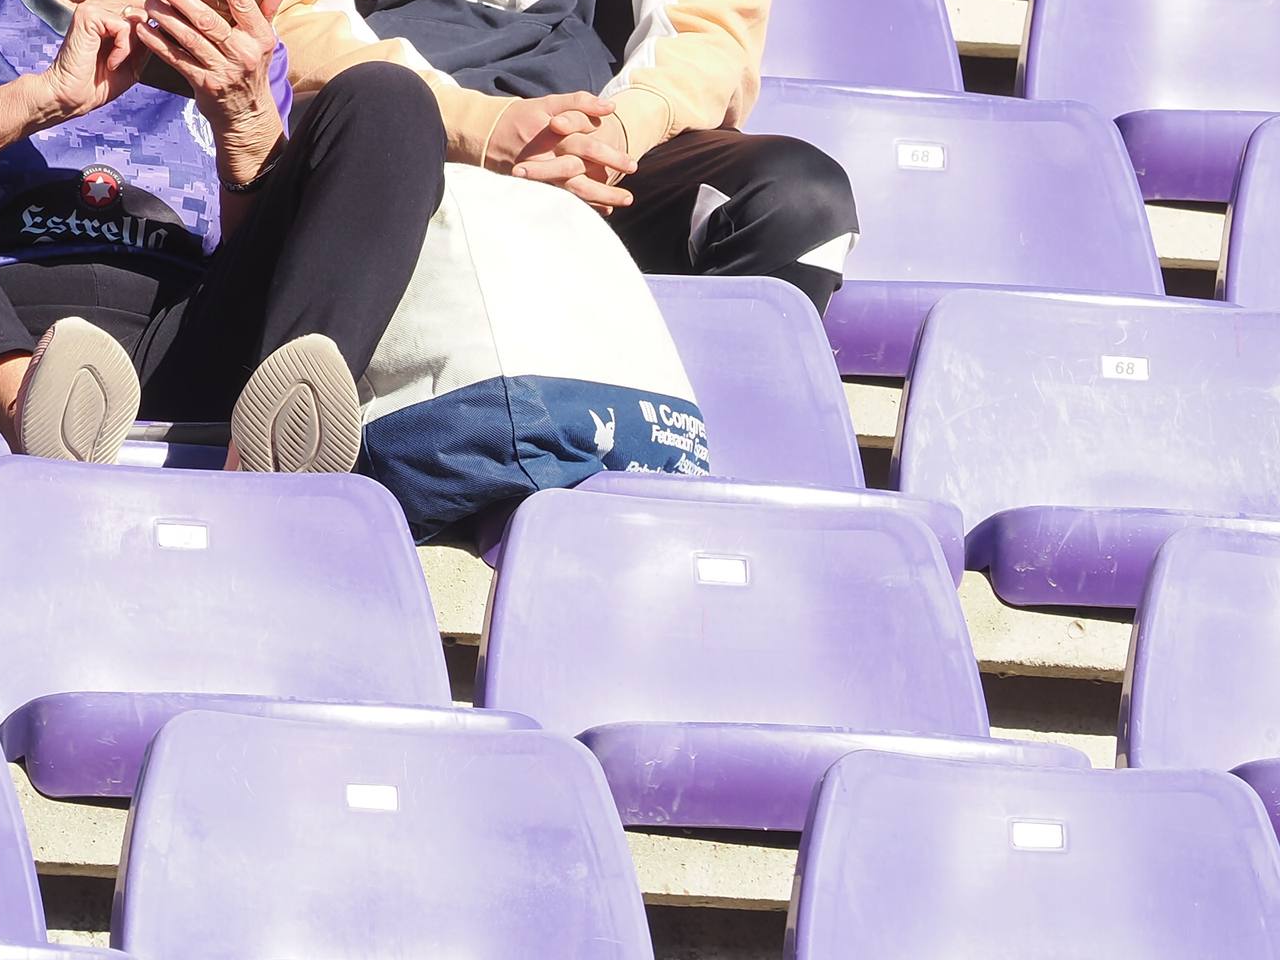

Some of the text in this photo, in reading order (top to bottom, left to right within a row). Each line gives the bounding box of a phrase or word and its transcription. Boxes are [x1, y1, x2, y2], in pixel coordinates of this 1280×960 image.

[911, 149, 930, 163] 68
[20, 204, 170, 249] Estrella
[1115, 361, 1135, 375] 68
